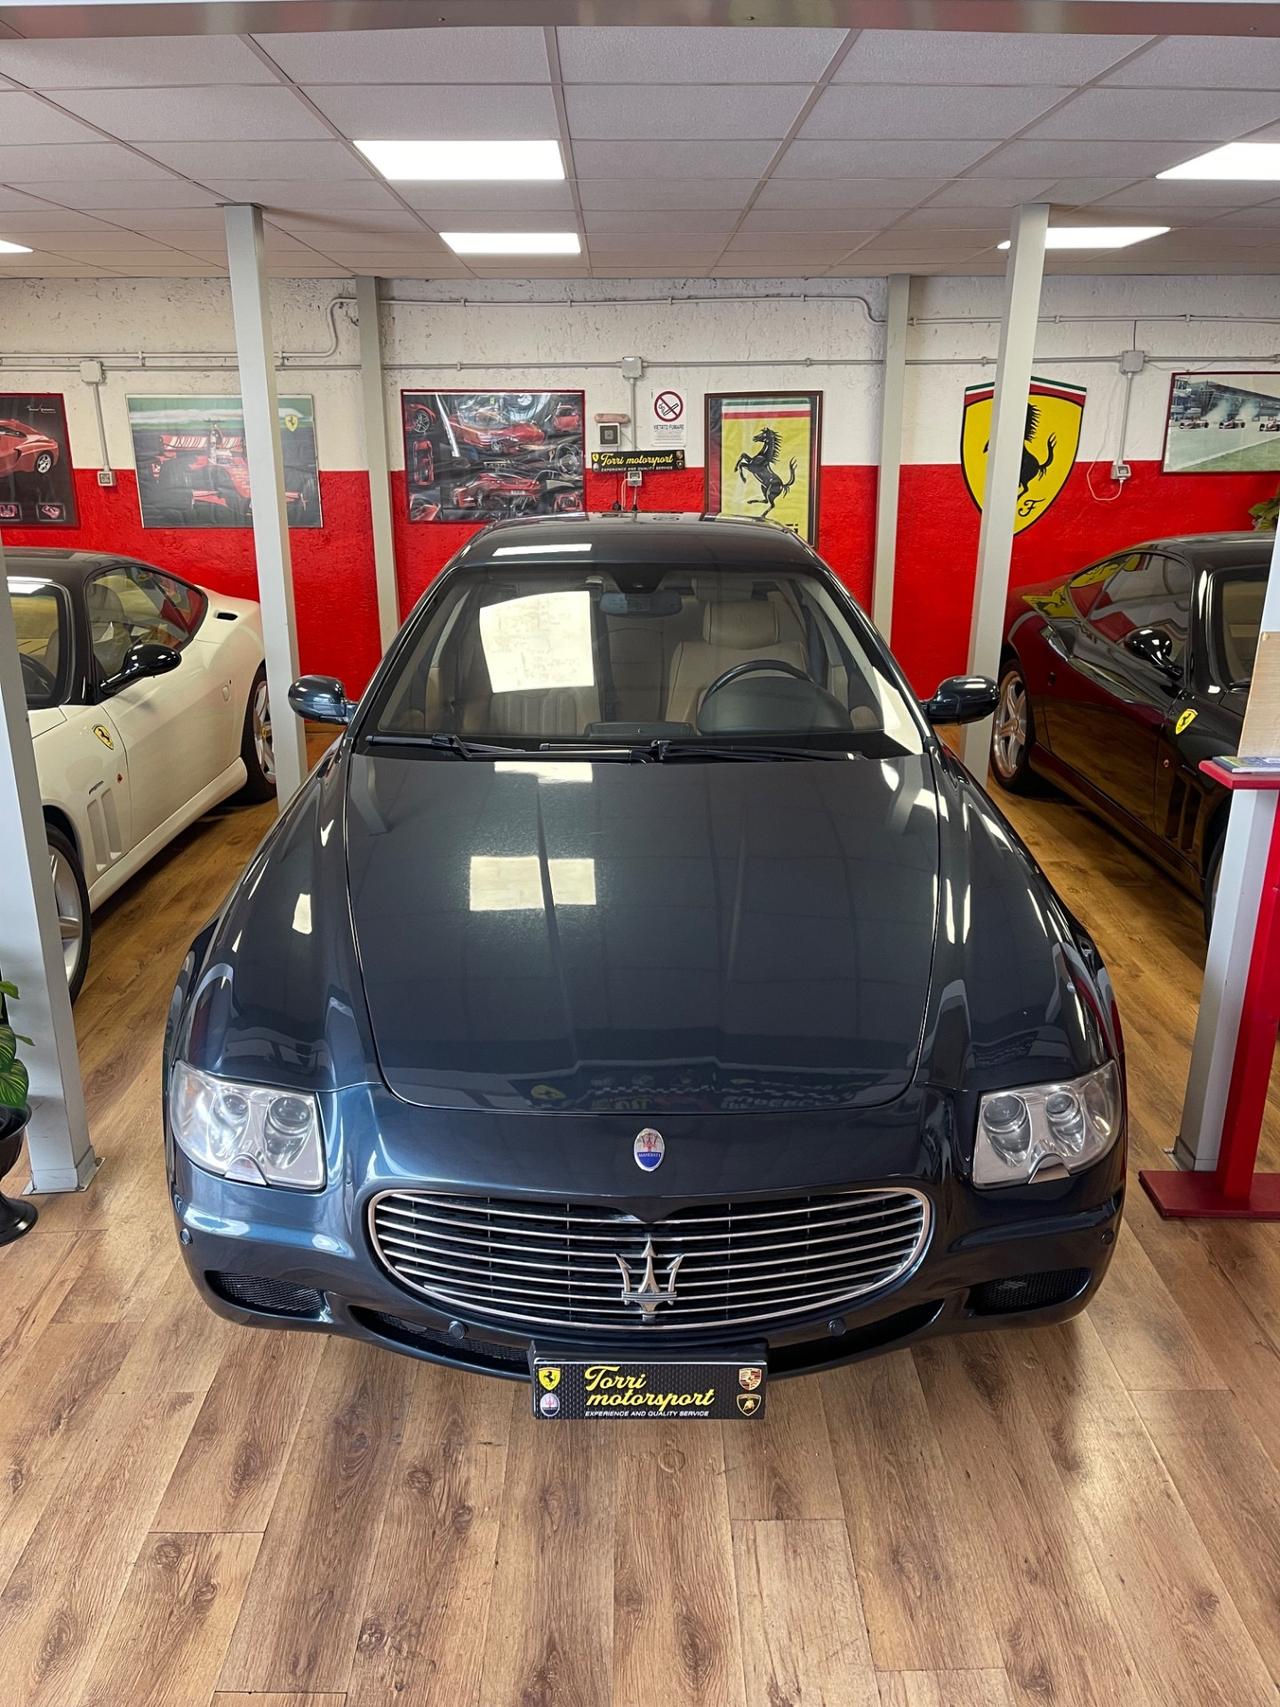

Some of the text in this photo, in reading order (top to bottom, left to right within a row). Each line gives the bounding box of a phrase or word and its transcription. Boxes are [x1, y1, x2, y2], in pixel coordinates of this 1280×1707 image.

[600, 453, 673, 467] Torri motorsport
[584, 1366, 647, 1391] Torri
[586, 1388, 716, 1413] motorsport
